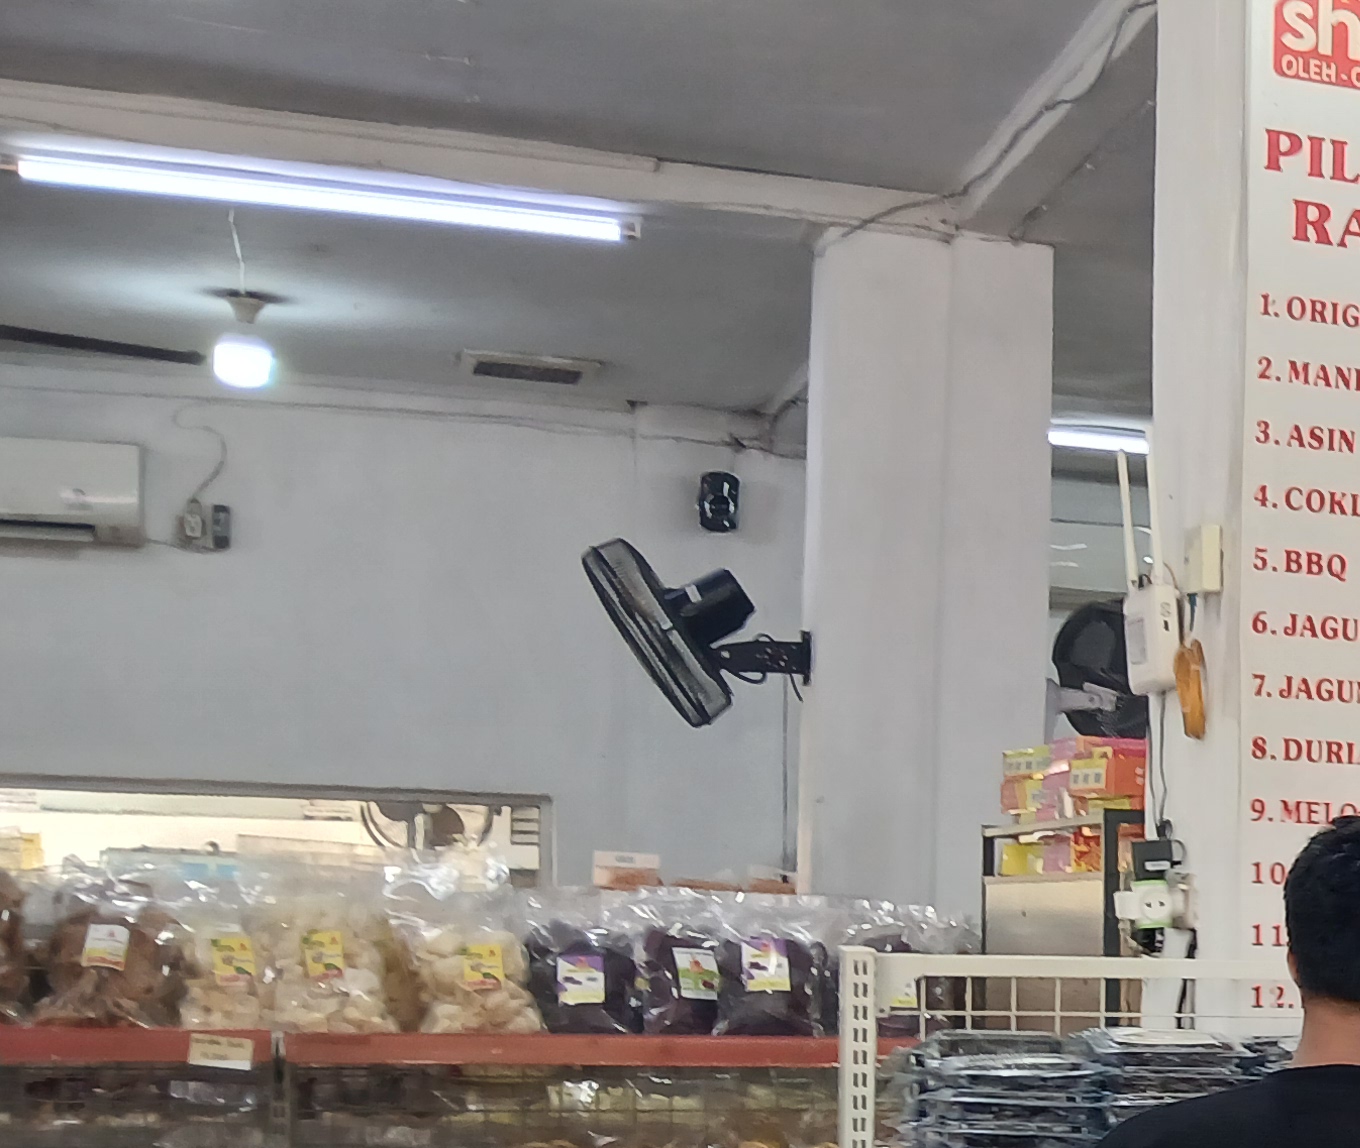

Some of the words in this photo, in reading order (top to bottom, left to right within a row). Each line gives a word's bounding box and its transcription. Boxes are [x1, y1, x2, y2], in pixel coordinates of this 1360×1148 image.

[1281, 56, 1338, 84] OLEH
[1257, 356, 1283, 384] 2.
[1254, 420, 1281, 447] 3.
[1286, 423, 1356, 454] ASIN
[1253, 484, 1279, 511] 4.
[1252, 547, 1279, 573] 5.
[1283, 549, 1348, 582] BBQ
[1251, 610, 1278, 636] 6.
[1251, 673, 1273, 700] 7.
[1251, 735, 1278, 761] 8.
[1250, 798, 1274, 821] 9.
